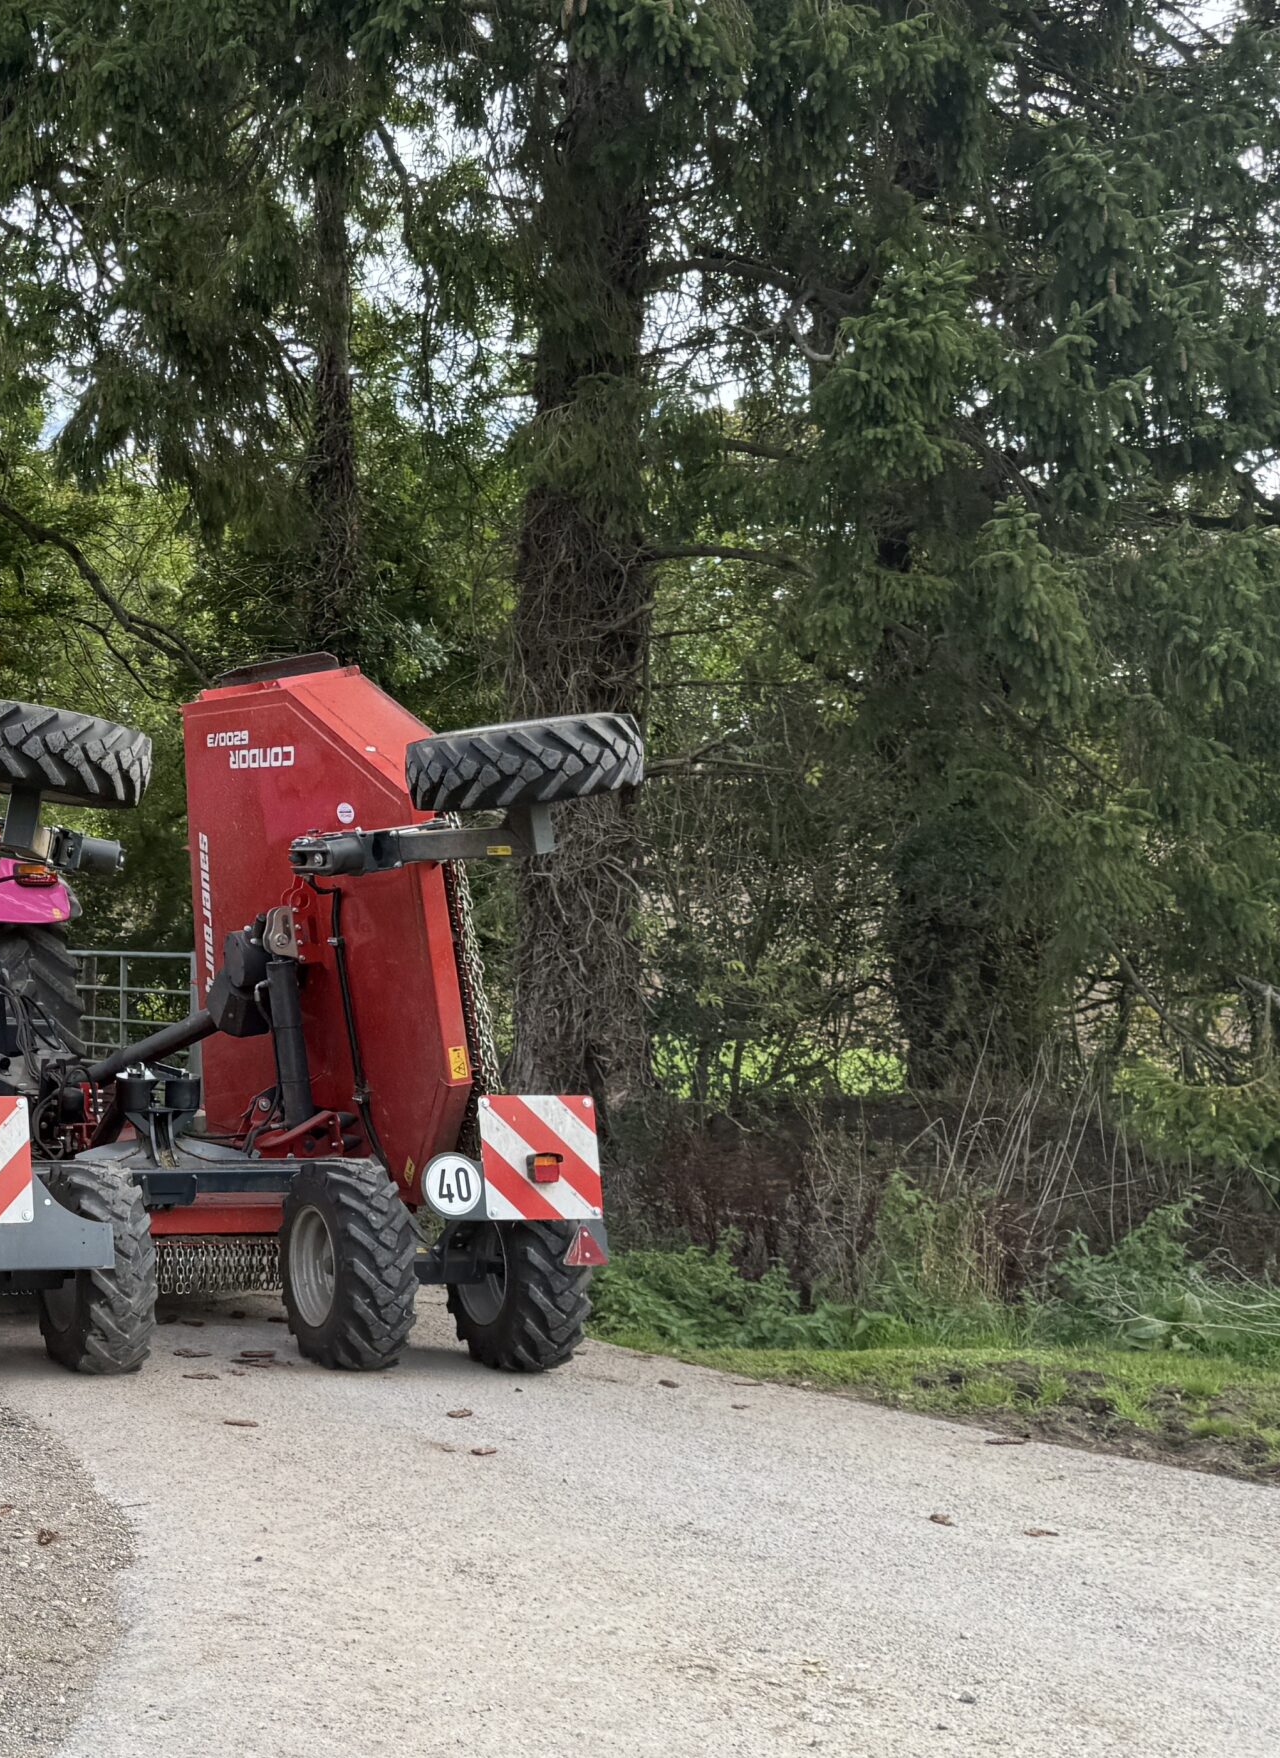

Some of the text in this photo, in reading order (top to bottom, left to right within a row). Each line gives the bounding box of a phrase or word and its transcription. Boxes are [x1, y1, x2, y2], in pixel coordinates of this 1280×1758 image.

[207, 730, 249, 747] 6200/3
[229, 746, 295, 769] CONDOR
[438, 1167, 472, 1203] 40
